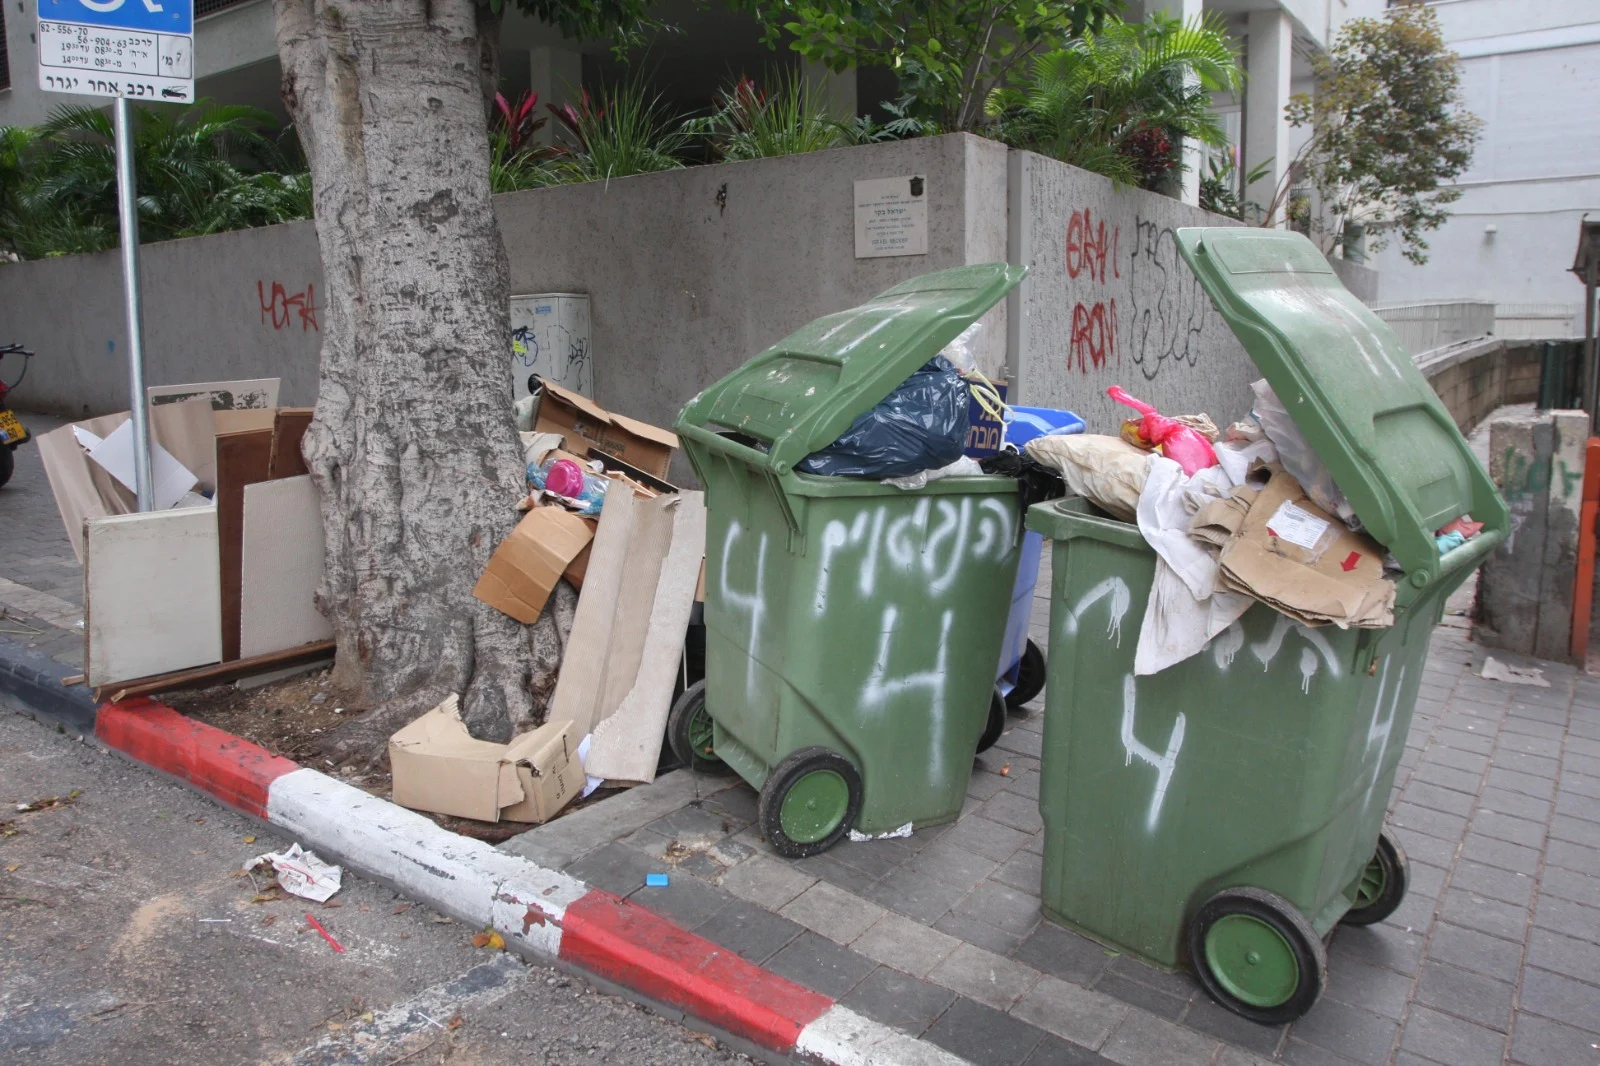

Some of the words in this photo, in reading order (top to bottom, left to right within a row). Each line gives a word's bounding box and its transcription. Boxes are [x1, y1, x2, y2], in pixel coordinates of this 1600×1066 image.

[128, 37, 153, 47] לרכב
[46, 75, 79, 90] יגרר
[88, 78, 119, 94] אחר
[127, 82, 155, 97] רכב
[966, 425, 999, 450] מובח
[1121, 672, 1187, 833] 4
